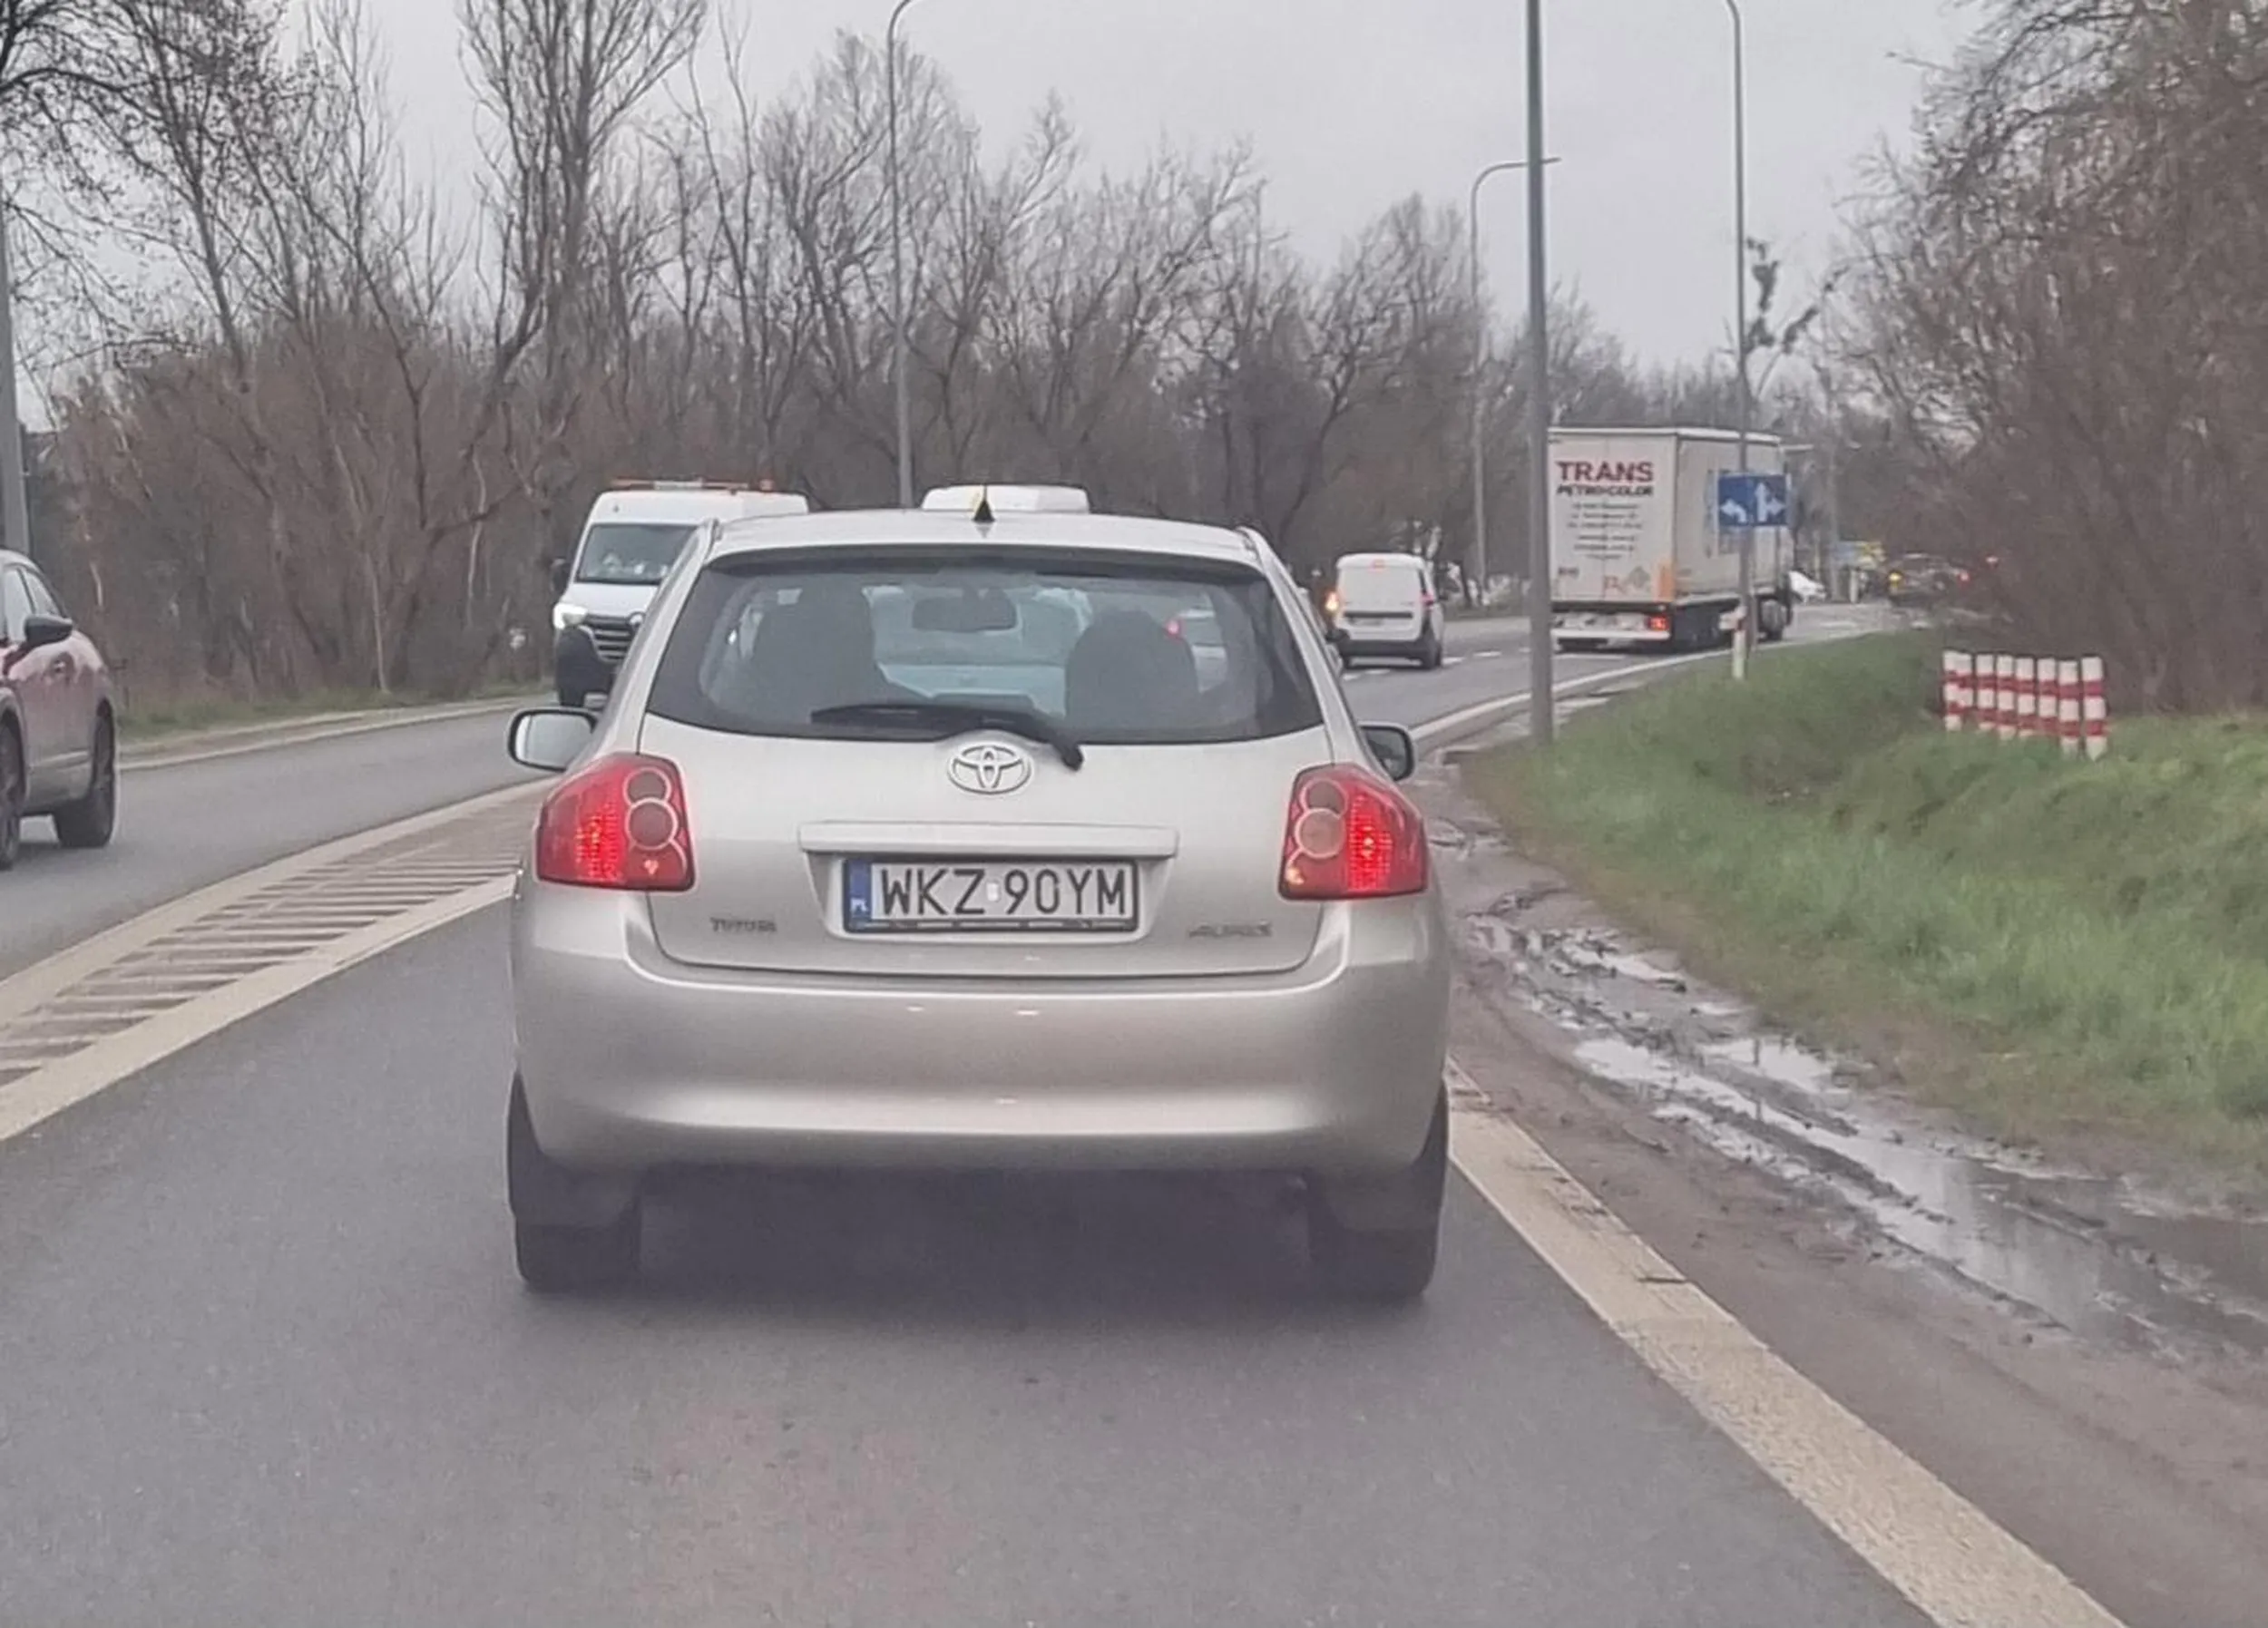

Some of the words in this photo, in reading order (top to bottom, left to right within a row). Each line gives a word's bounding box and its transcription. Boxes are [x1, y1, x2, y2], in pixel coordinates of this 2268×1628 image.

[1555, 461, 1654, 482] TRANS
[881, 868, 986, 915] WKZ
[1003, 868, 1126, 915] 90YM
